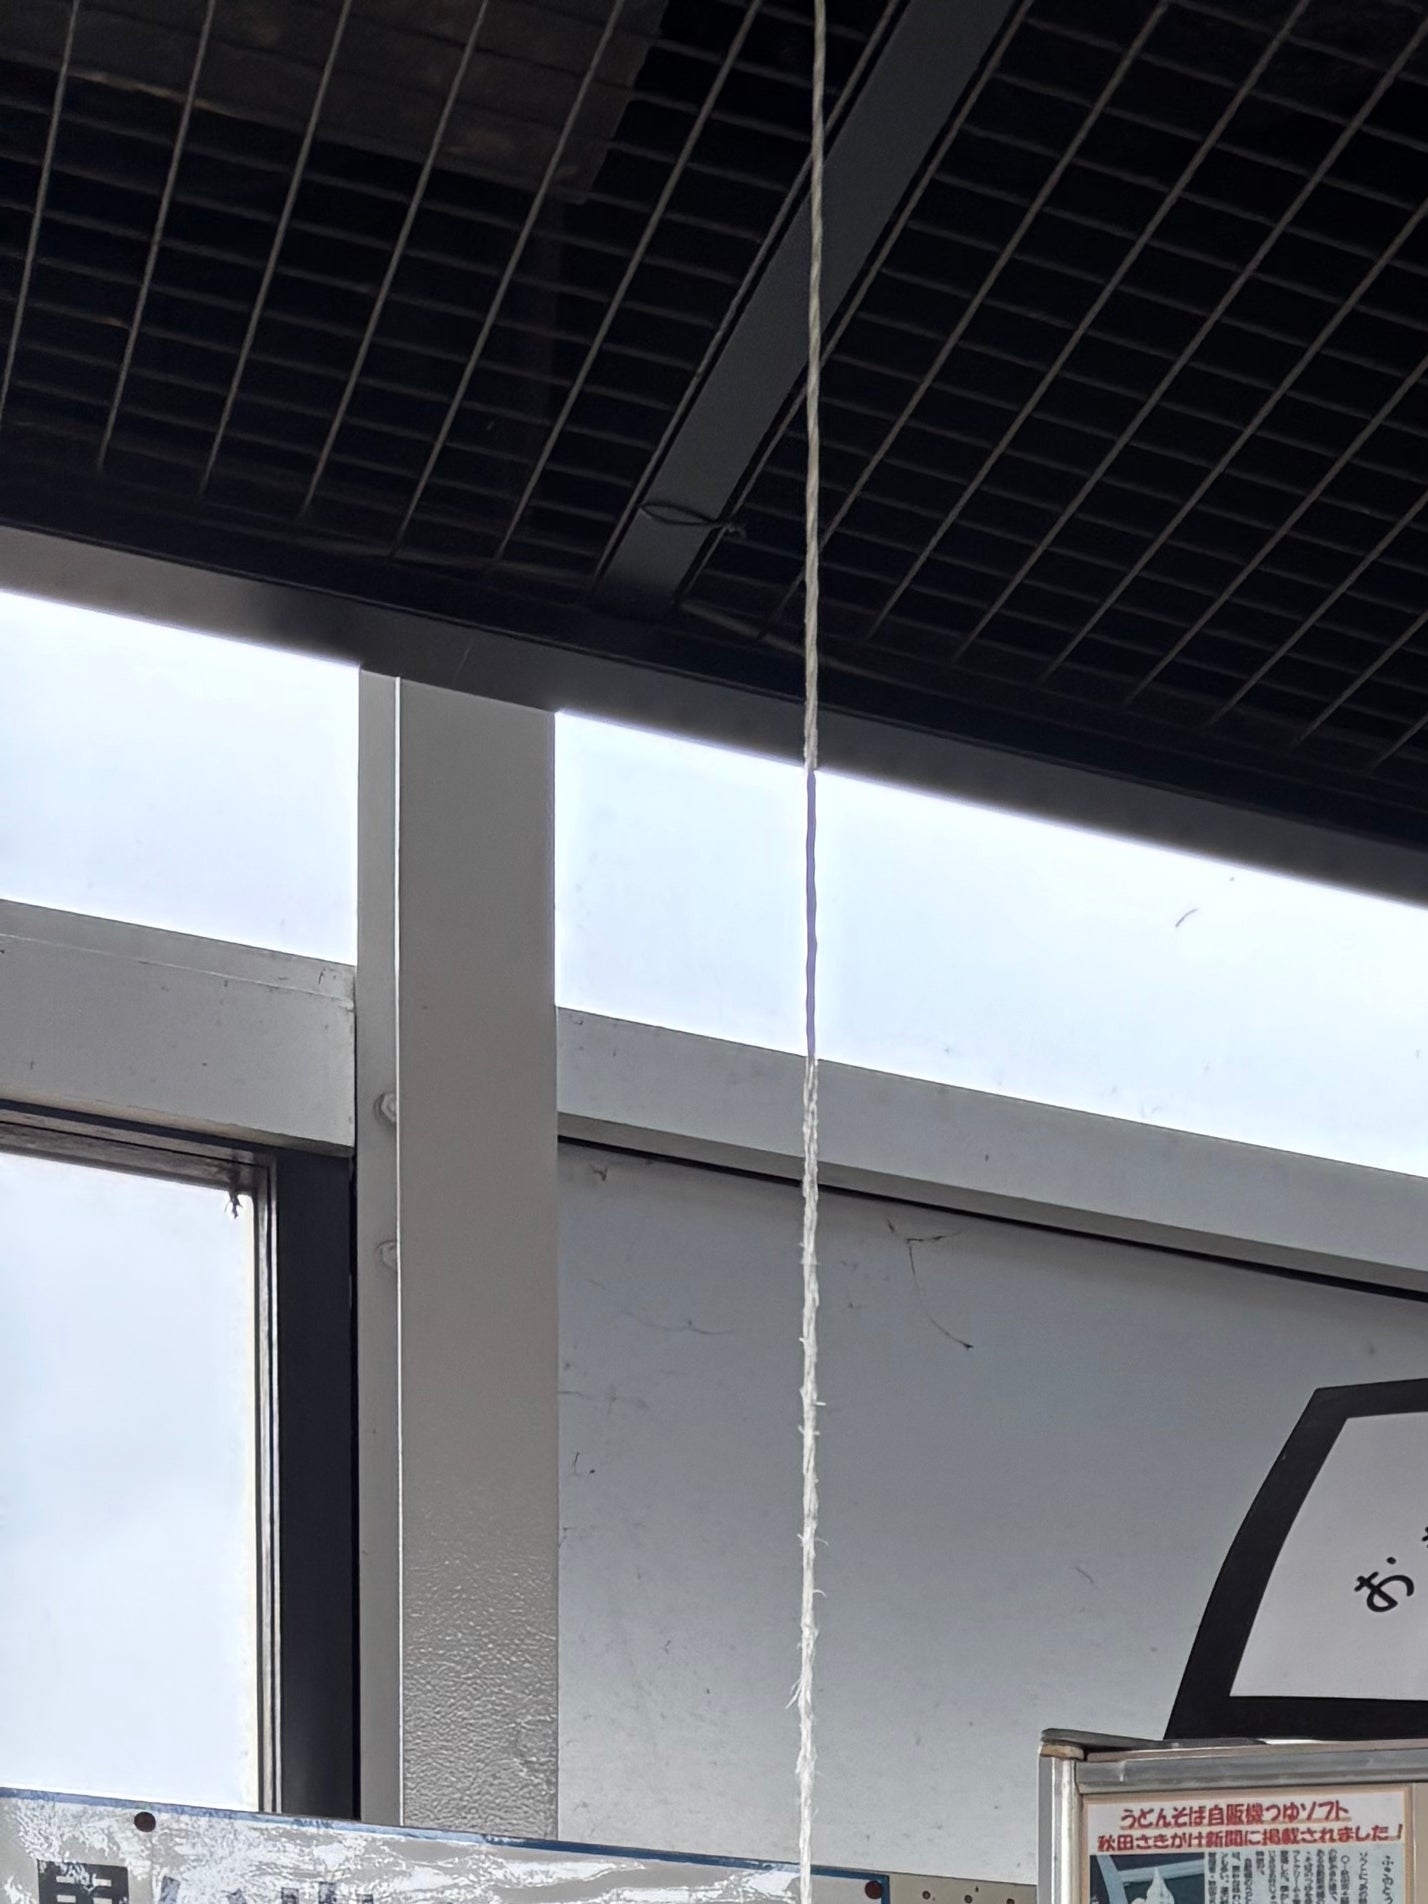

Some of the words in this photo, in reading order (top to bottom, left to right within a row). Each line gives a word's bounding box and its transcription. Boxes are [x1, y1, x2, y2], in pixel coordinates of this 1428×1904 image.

[1121, 1801, 1348, 1830] うどんそば自販機つゆソフト
